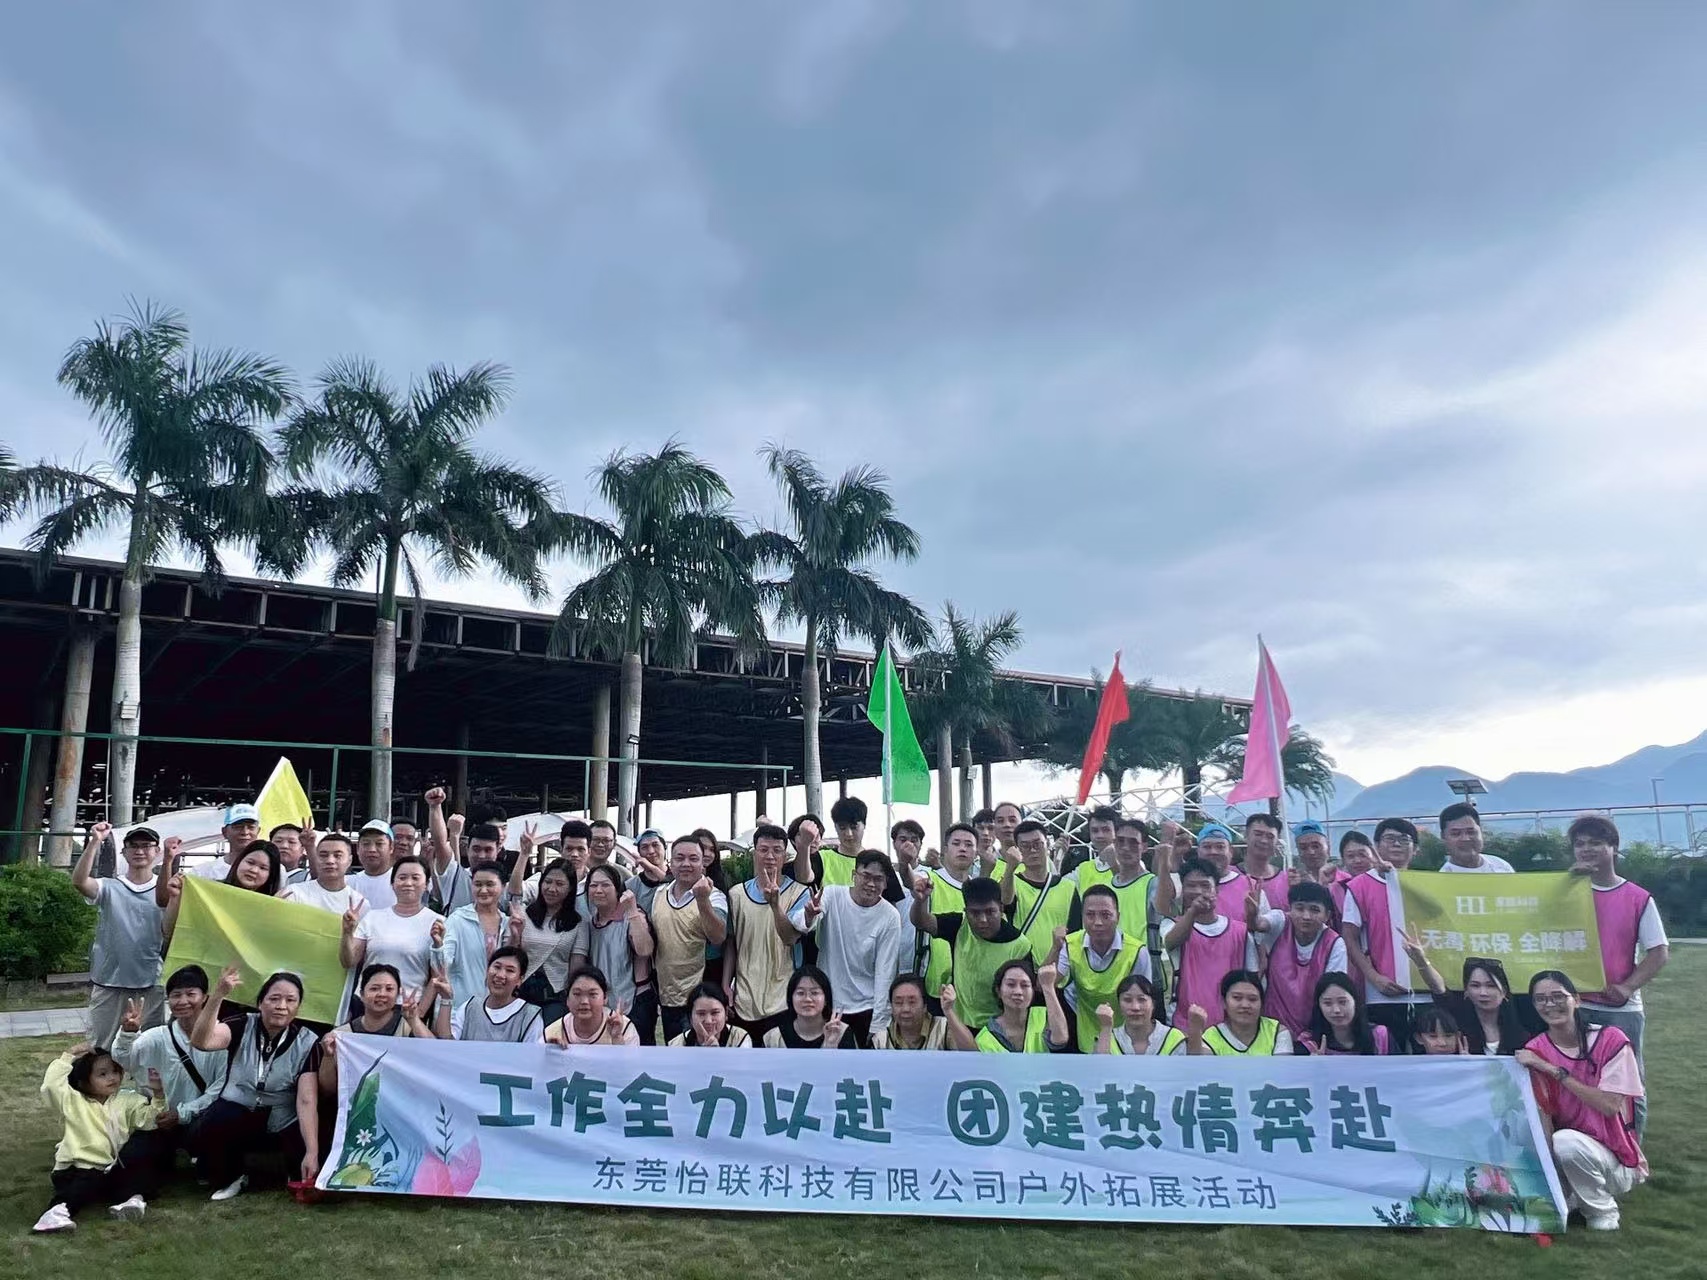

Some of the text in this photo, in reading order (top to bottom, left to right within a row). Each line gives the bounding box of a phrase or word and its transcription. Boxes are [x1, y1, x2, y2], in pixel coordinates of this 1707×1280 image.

[1469, 933, 1512, 953] 环保
[478, 1071, 1396, 1153] 工作全力以赴 团建热情奔赴
[593, 1157, 1276, 1209] 东莞怡联科技有限公司户外拓展活动
